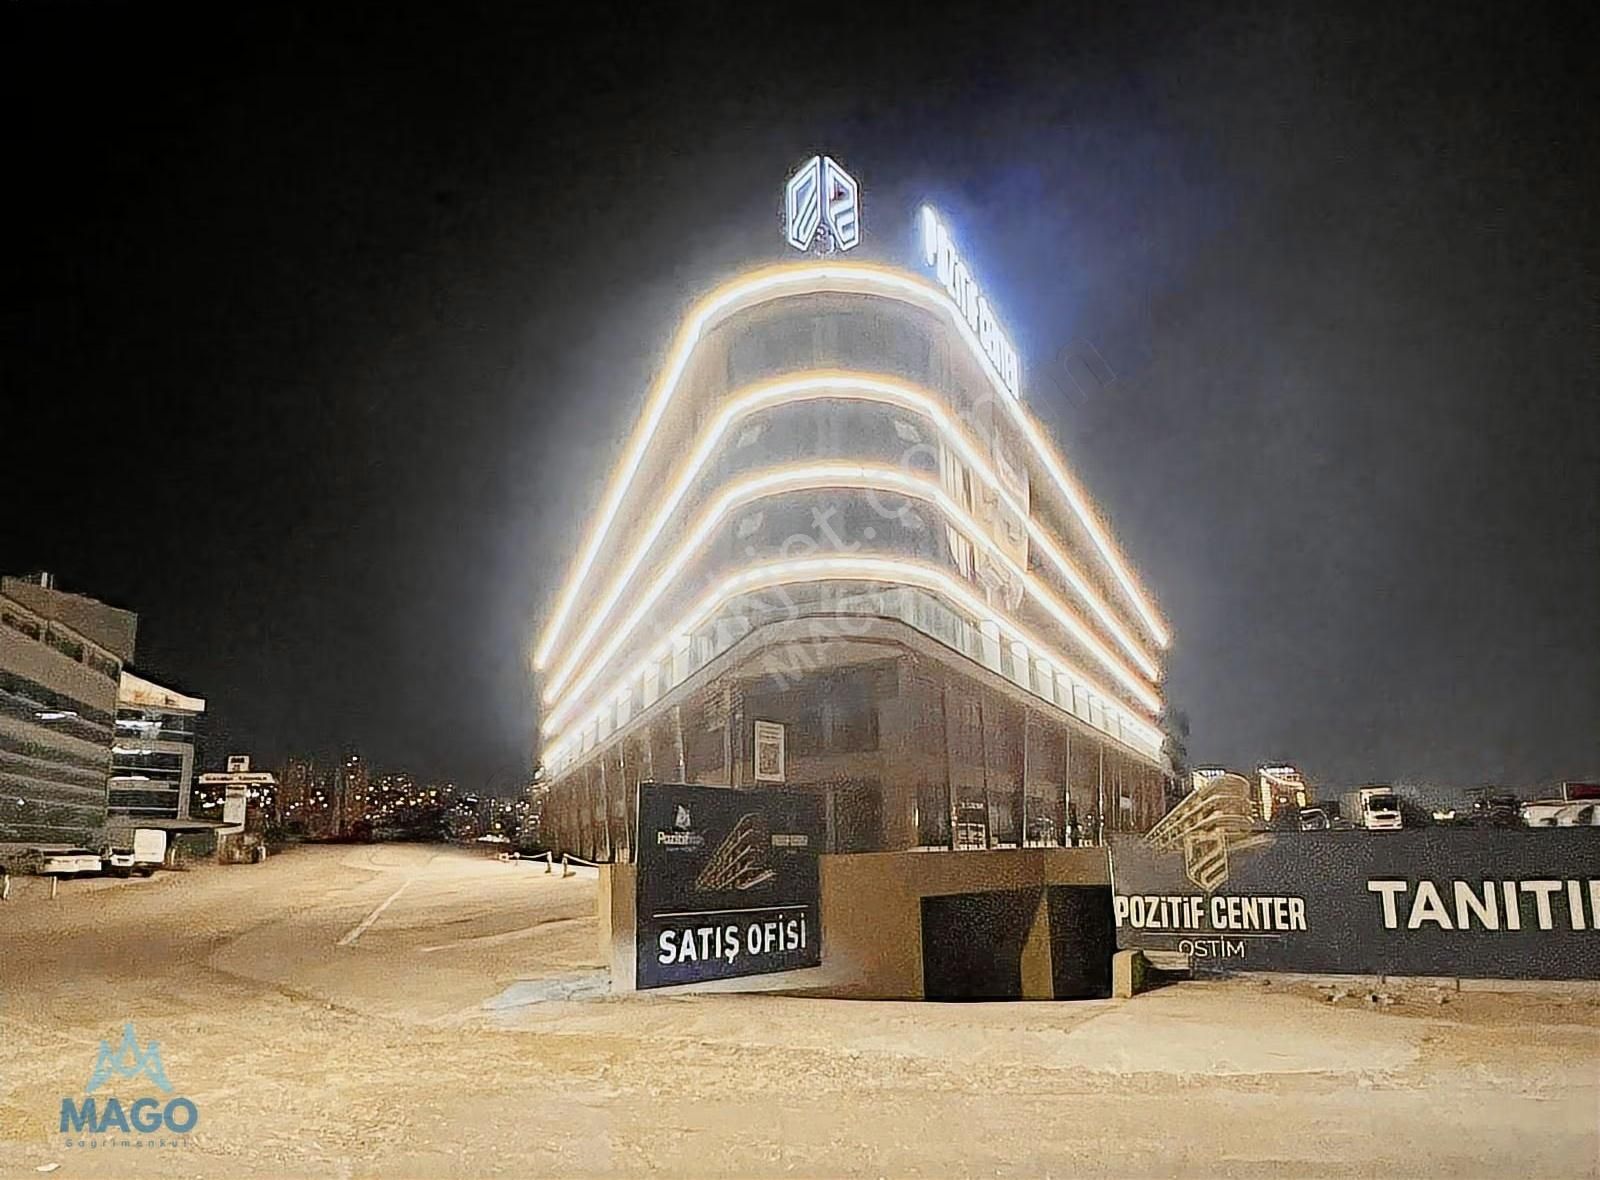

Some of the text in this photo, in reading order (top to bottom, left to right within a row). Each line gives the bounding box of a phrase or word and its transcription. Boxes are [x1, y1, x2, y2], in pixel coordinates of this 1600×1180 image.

[1211, 896, 1307, 931] CENTER
[658, 912, 806, 965] SATIŞ OFİSİ
[1178, 935, 1245, 959] OSTİM
